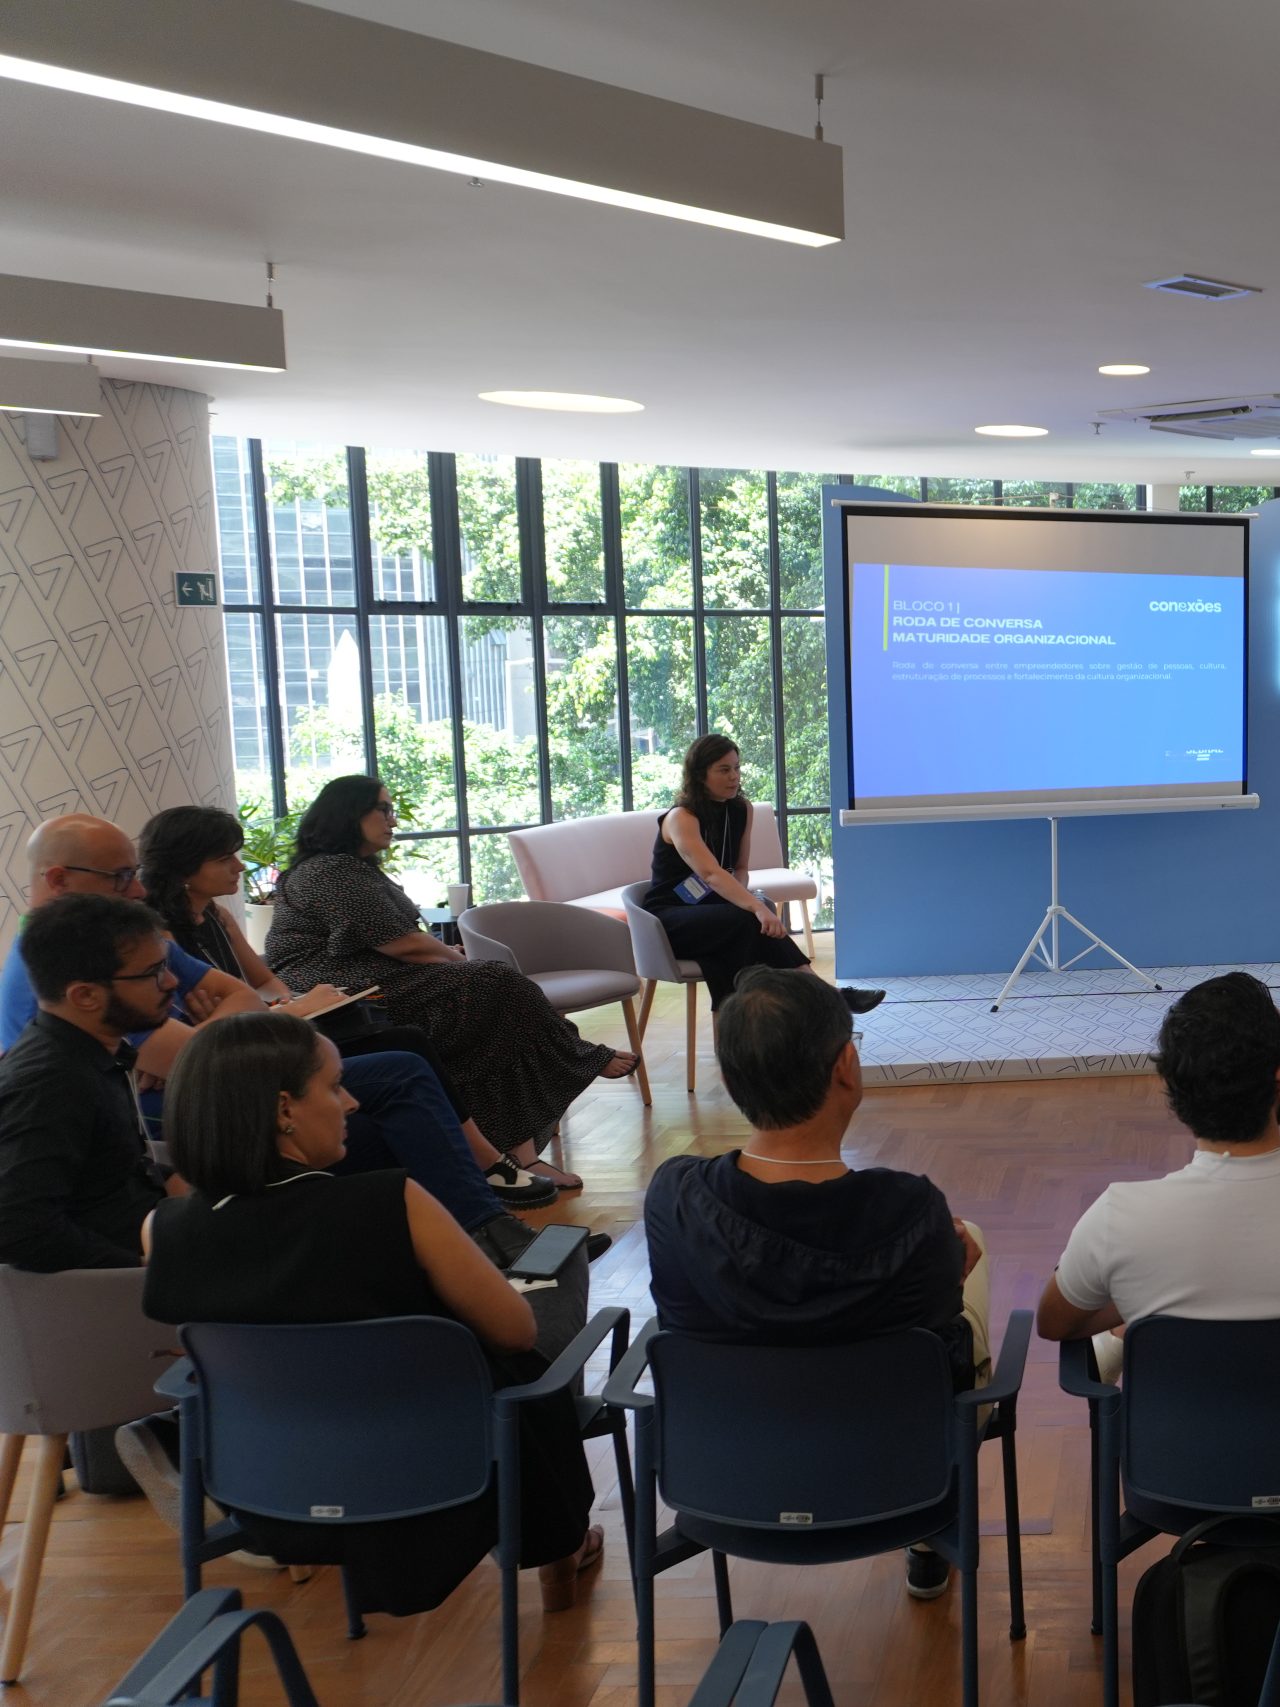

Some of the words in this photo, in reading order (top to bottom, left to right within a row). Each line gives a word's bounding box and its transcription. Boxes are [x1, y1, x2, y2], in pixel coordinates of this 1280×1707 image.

[893, 600, 944, 612] BLOCO
[1149, 598, 1222, 613] conexões
[893, 616, 936, 627] RODA
[940, 617, 961, 627] DE
[963, 618, 1043, 629] CONVERSA
[892, 632, 991, 644] MATURIDADE
[994, 633, 1116, 645] ORGANIZACIONAL
[892, 661, 916, 670] Roda
[922, 661, 935, 670] de
[940, 662, 979, 670] conversa
[985, 662, 1008, 670] entre
[1013, 661, 1084, 672] empreendedores
[1088, 661, 1111, 670] sobre
[1116, 661, 1143, 672] gestão
[1148, 661, 1158, 670] de
[892, 671, 949, 683] estruturação
[950, 672, 962, 681] de
[964, 673, 1006, 683] processos
[1013, 671, 1074, 681] fortalecimento
[1075, 672, 1086, 681] da
[1086, 672, 1115, 681] cultura
